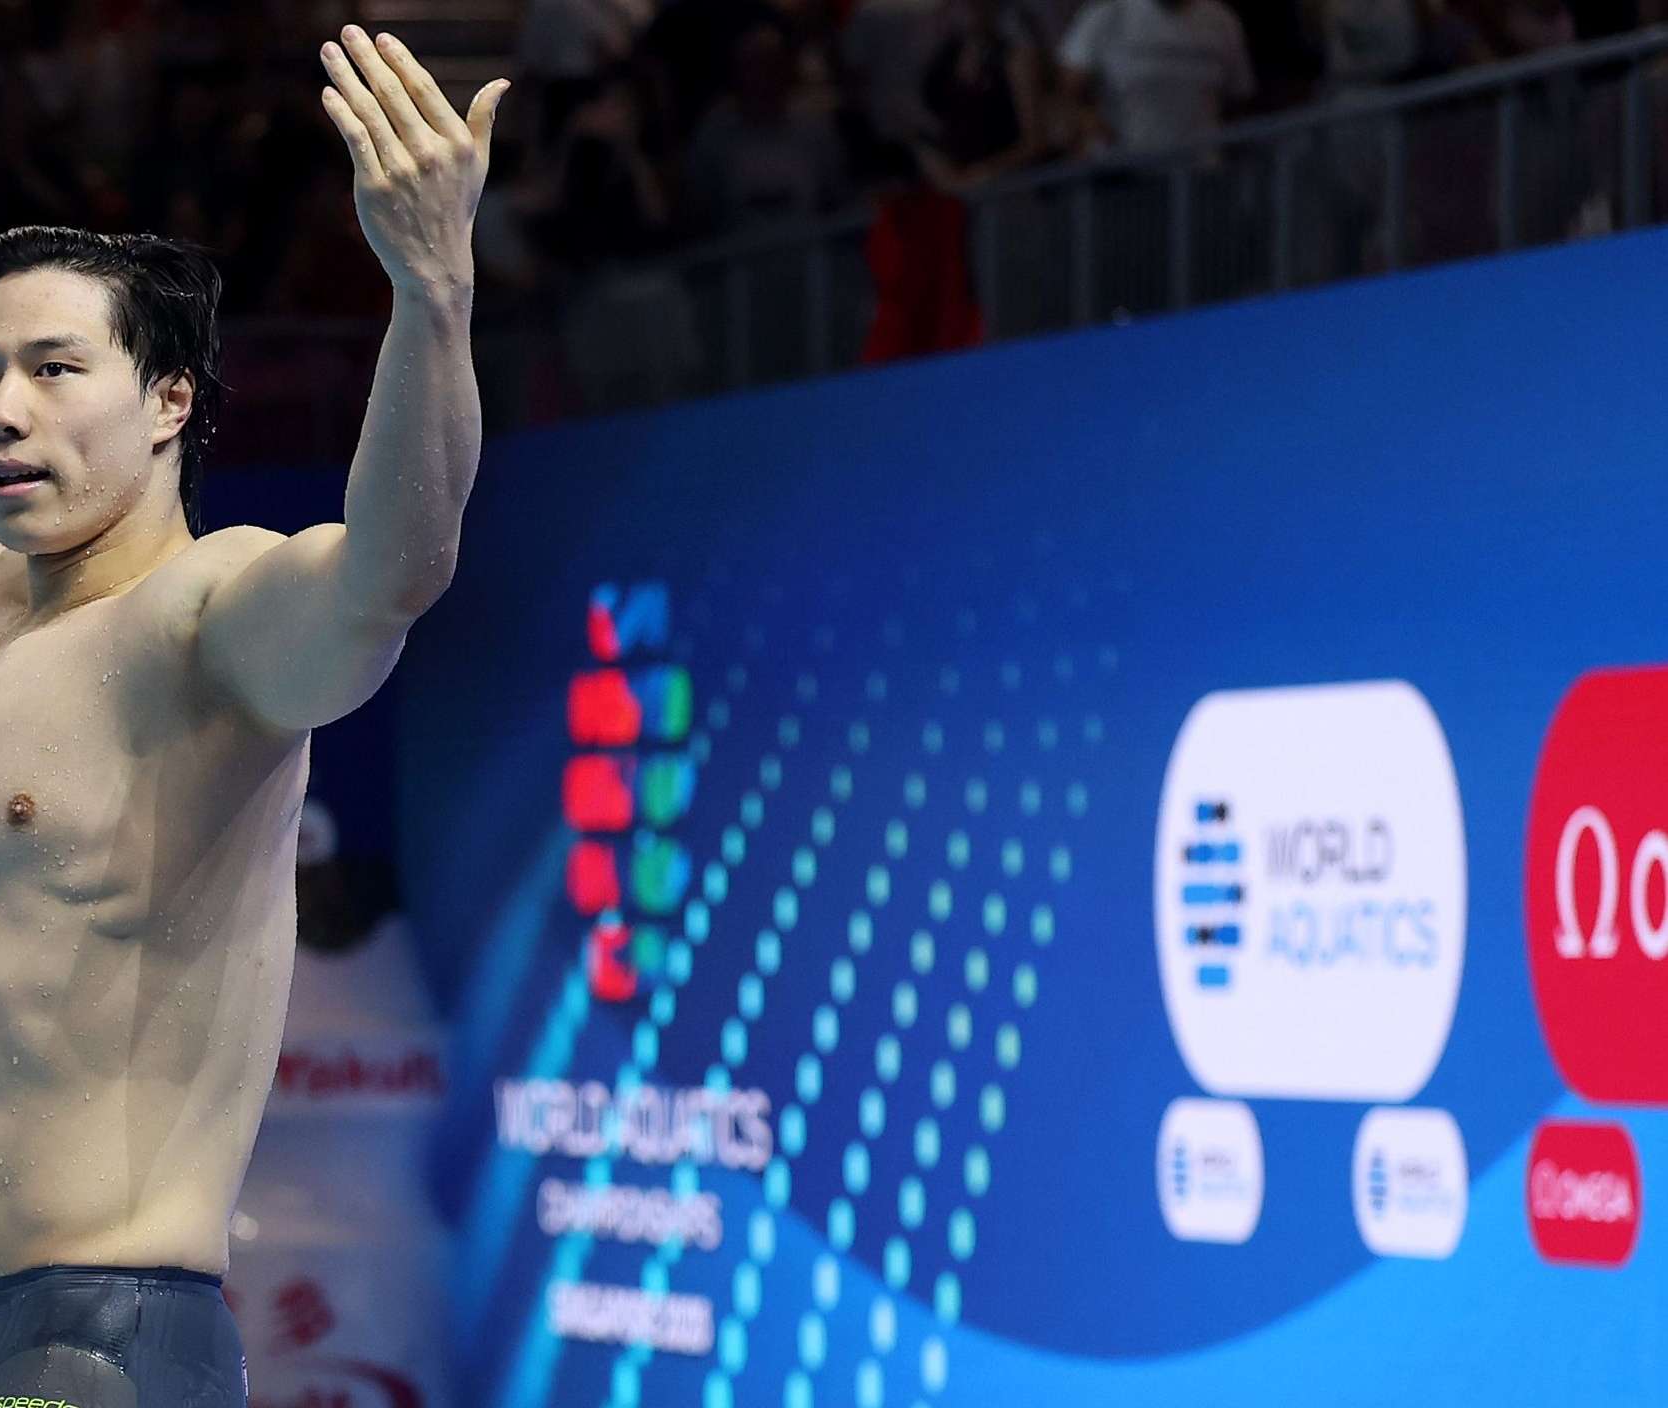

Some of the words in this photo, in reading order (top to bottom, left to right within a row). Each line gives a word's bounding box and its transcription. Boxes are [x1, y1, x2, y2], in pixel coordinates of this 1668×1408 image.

[1267, 816, 1395, 885] WORLD
[1269, 900, 1440, 968] AQUATICS
[493, 1076, 611, 1157] WORLD
[613, 1084, 774, 1172] AQUATICS
